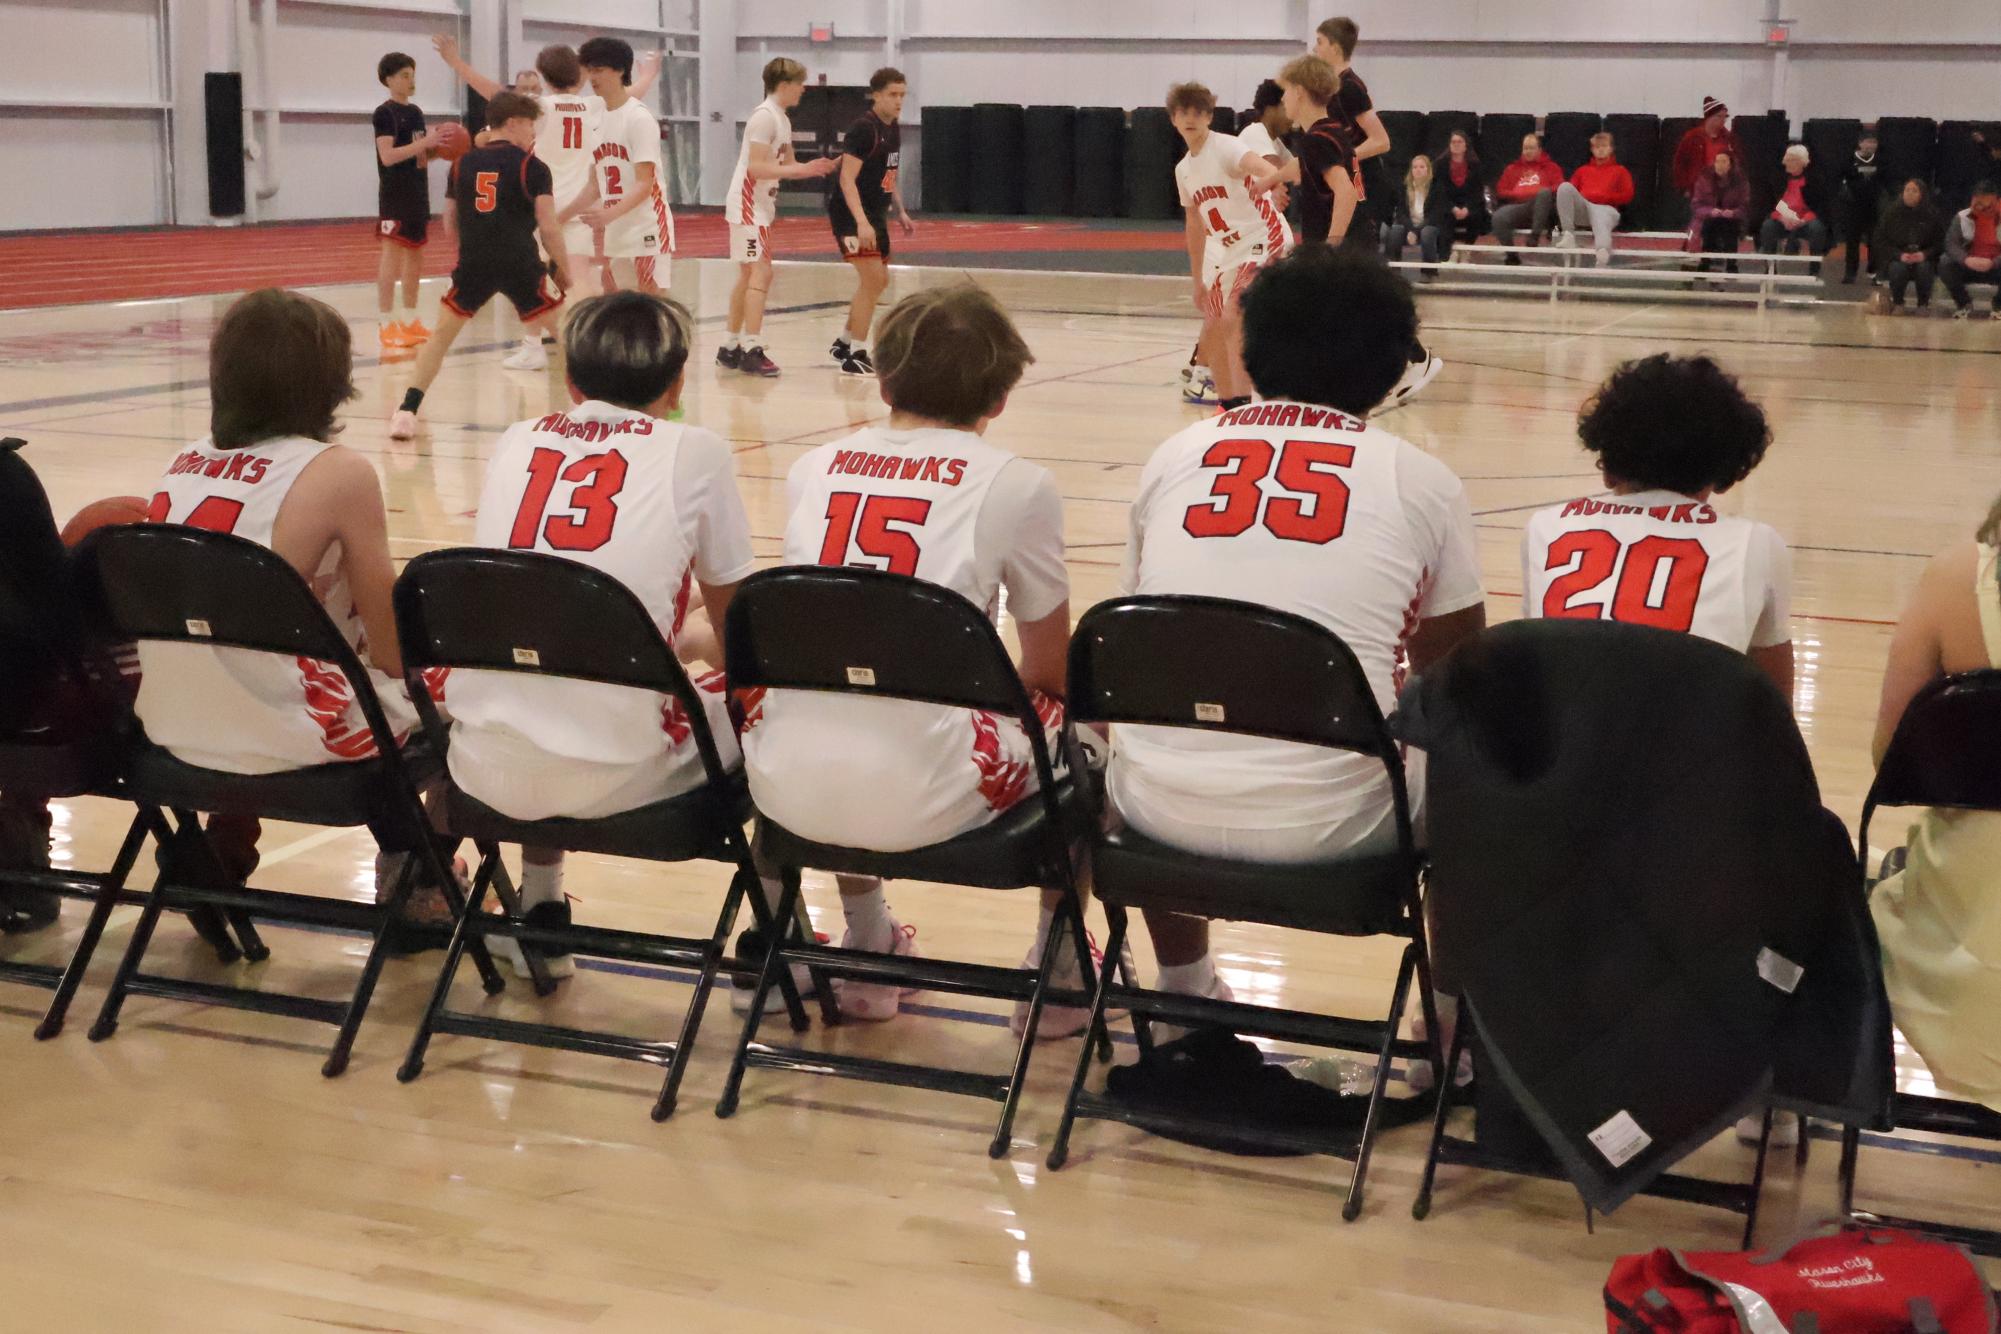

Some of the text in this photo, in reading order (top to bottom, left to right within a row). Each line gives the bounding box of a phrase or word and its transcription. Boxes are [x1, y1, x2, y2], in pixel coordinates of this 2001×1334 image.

[563, 117, 582, 149] 11
[475, 172, 499, 213] 5
[747, 239, 756, 257] MC
[1217, 405, 1367, 432] MOHAWKS
[827, 449, 968, 487] MOHAWKS
[508, 447, 629, 552] 13
[1182, 438, 1356, 545] 35
[818, 491, 932, 577] 15
[1542, 528, 1710, 633] 20
